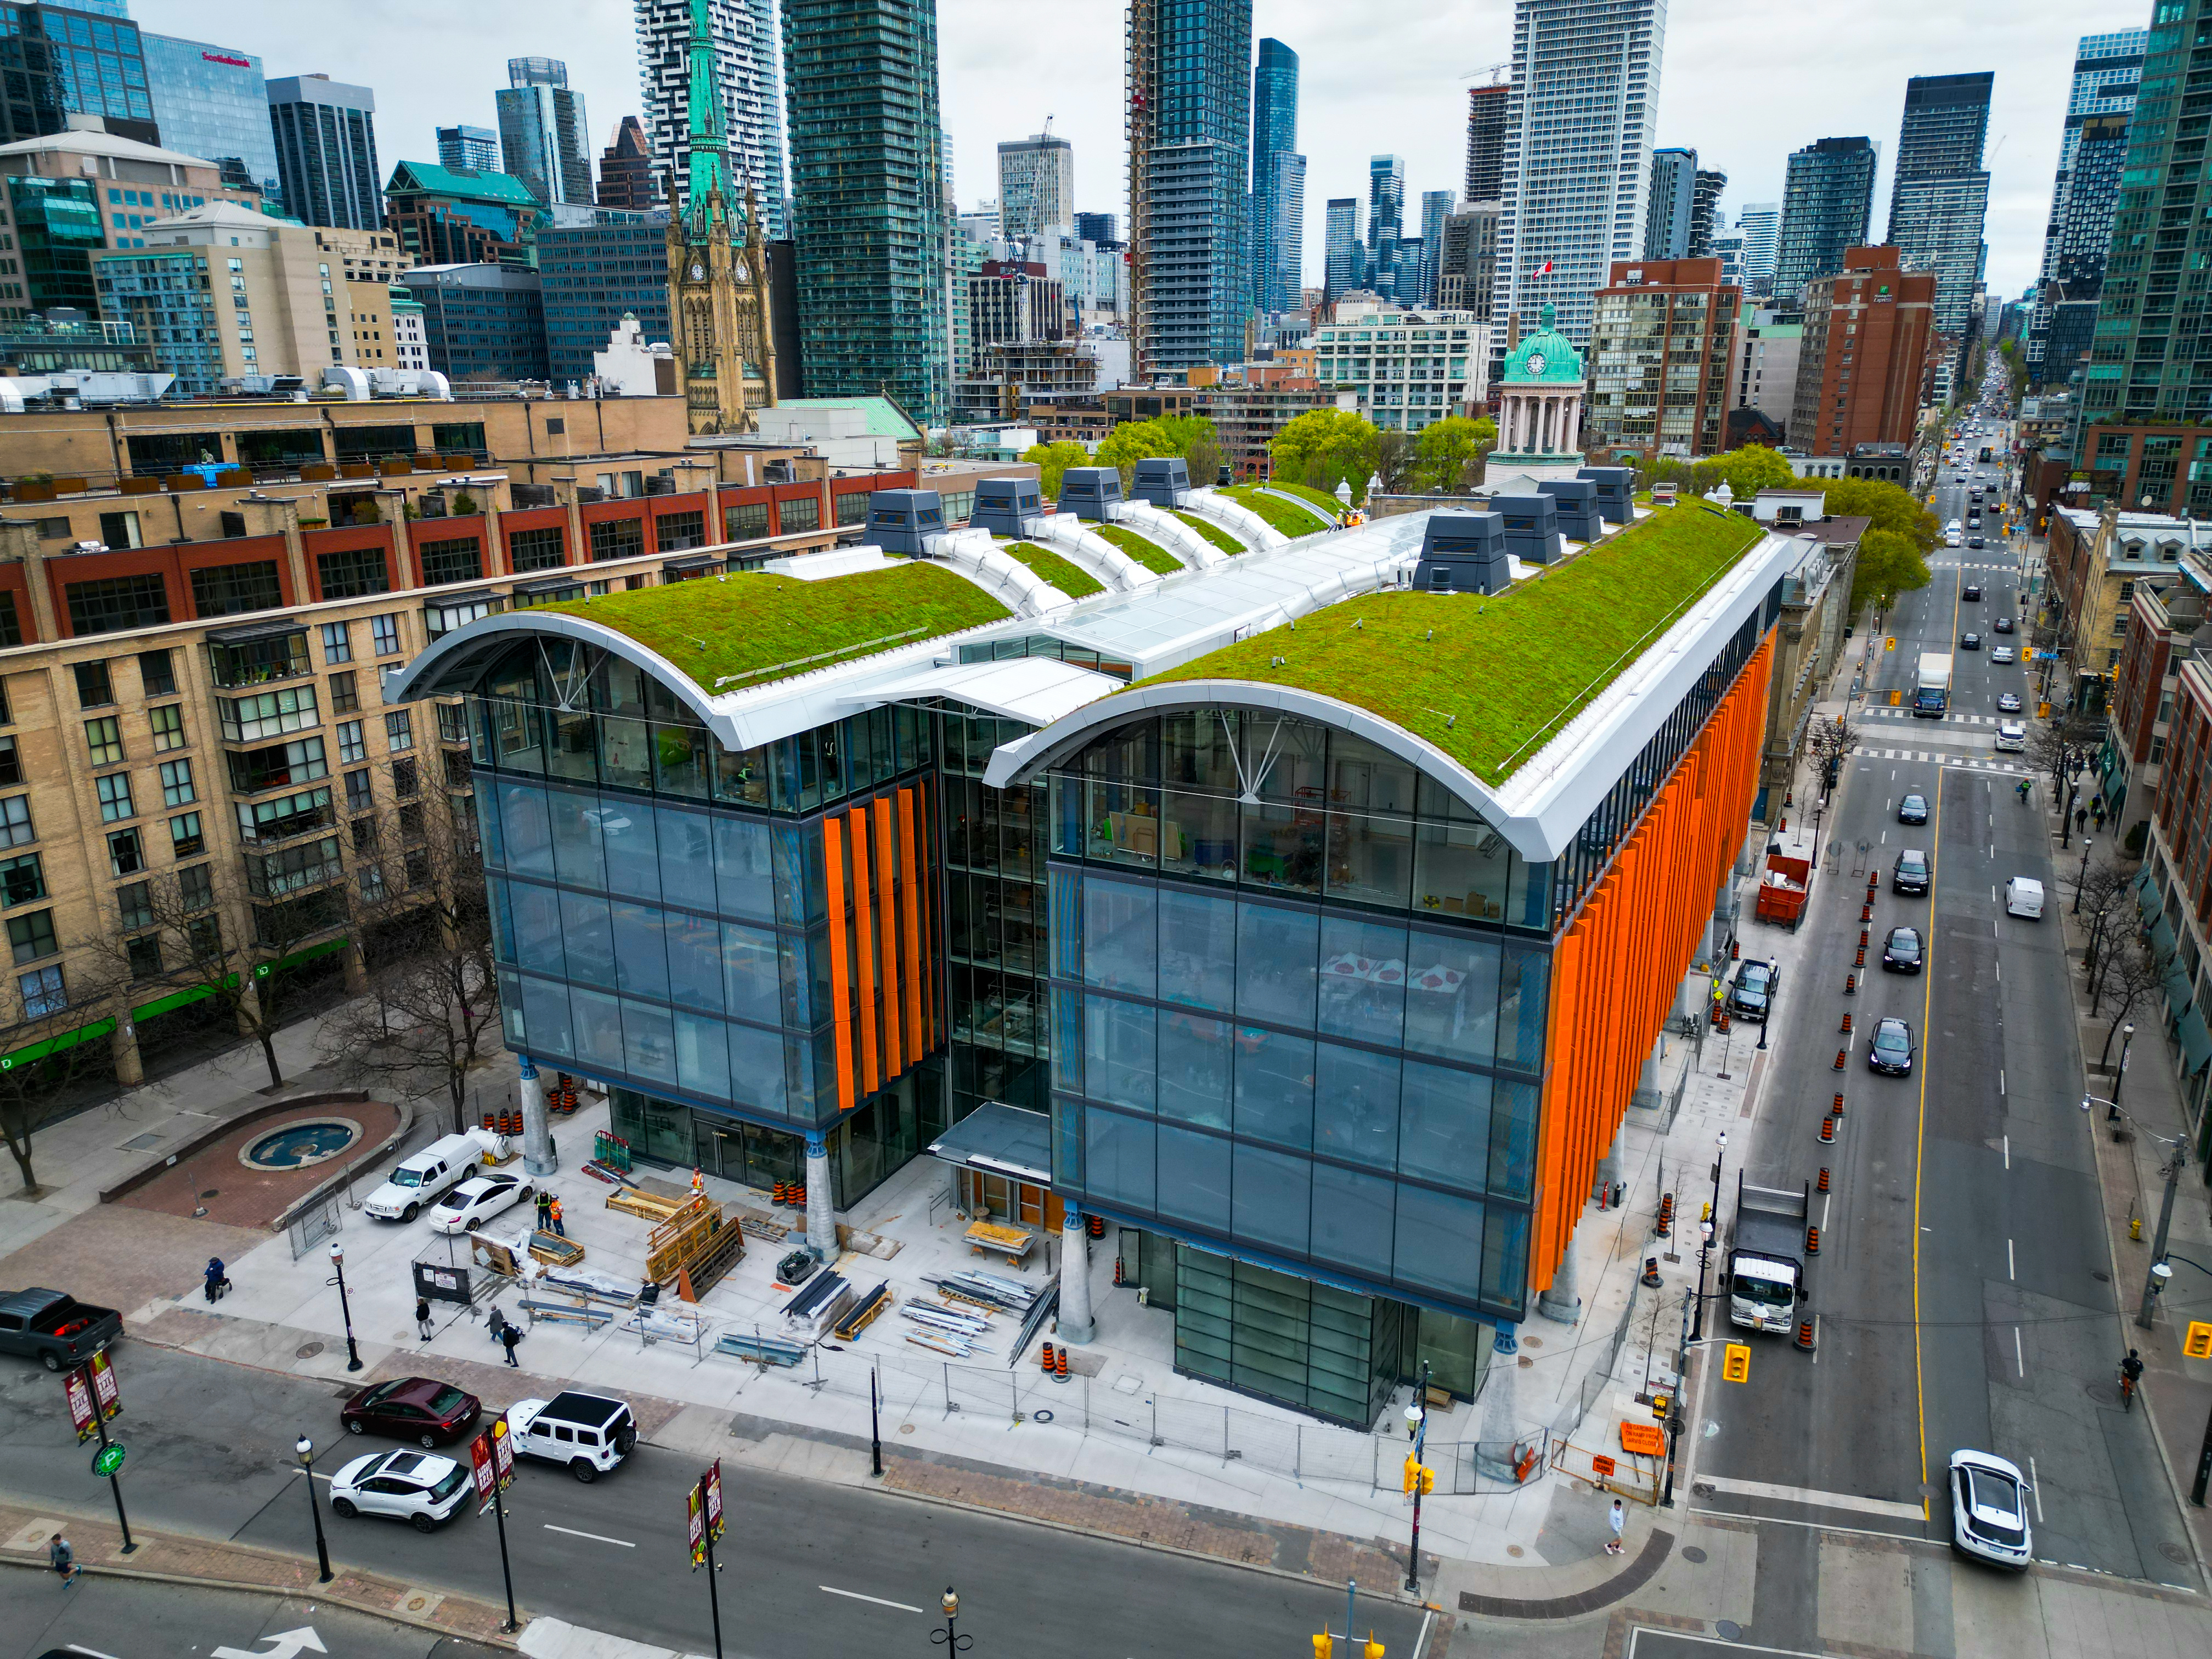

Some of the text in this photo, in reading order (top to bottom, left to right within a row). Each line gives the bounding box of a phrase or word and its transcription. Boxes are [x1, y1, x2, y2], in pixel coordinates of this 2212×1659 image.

[202, 52, 250, 68] Scotiabank
[98, 1374, 114, 1392] OPEN
[71, 1393, 88, 1412] OPEN
[105, 1451, 116, 1467] P
[498, 1440, 510, 1460] OPEN
[478, 1462, 491, 1479] MARKET
[479, 1468, 493, 1487] OPEN
[709, 1497, 720, 1516] OPEN
[690, 1519, 701, 1539] OPEN
